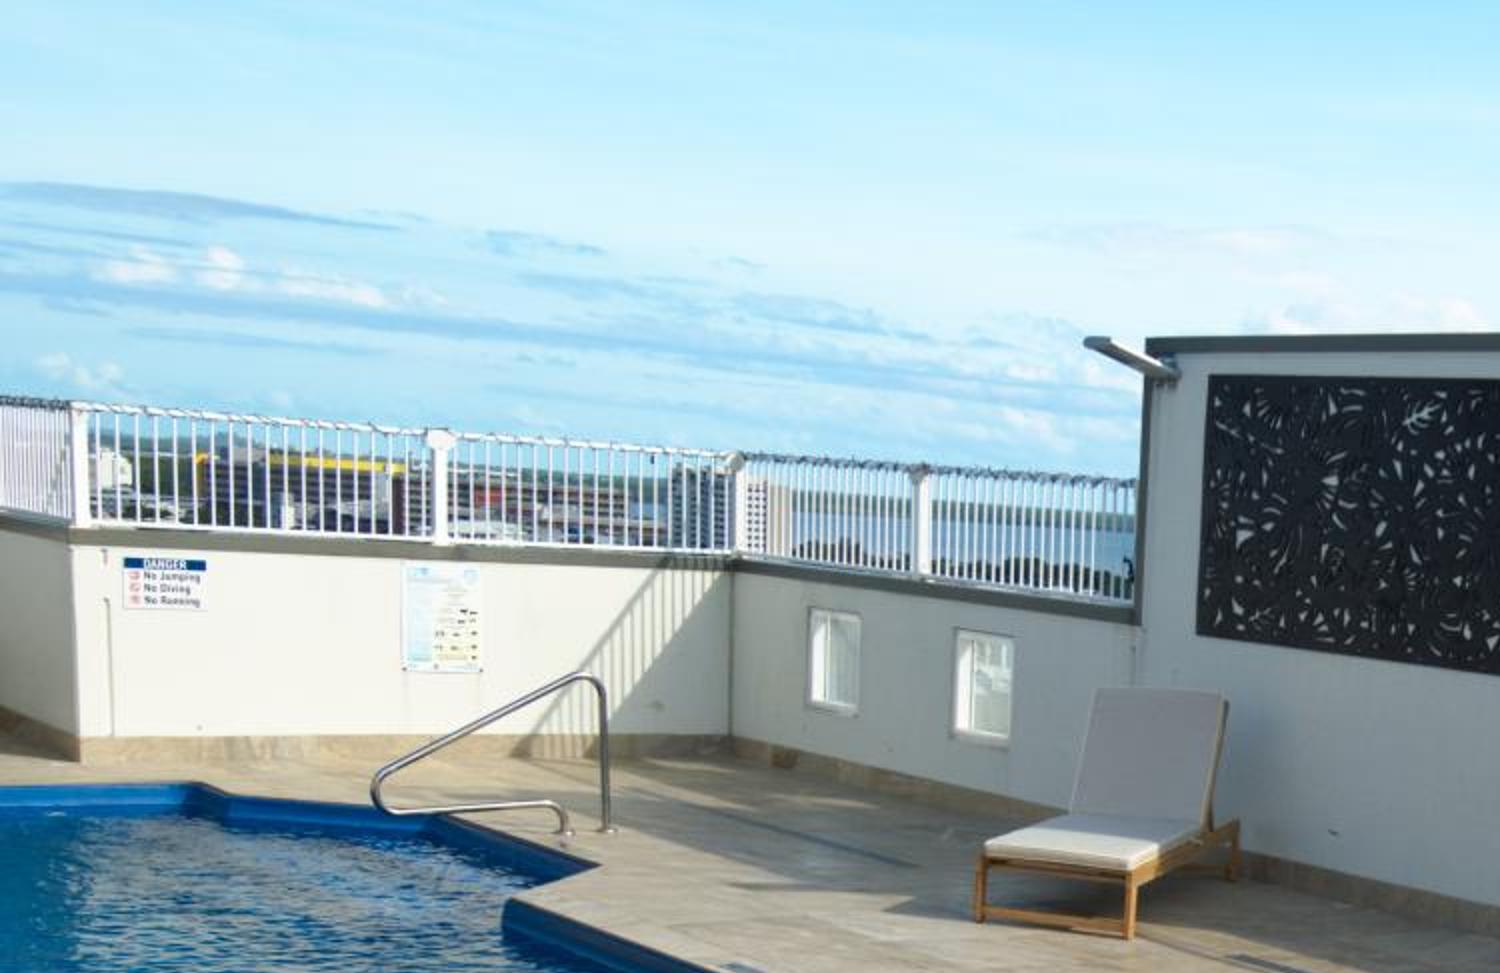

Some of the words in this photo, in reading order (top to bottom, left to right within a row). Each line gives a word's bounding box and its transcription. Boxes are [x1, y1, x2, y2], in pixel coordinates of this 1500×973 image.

[144, 558, 187, 570] DANGER
[144, 572, 157, 581] No
[160, 572, 201, 583] Jumping
[144, 584, 157, 592] No
[160, 584, 191, 595] Diving
[144, 596, 158, 605] No
[160, 596, 201, 608] Running
